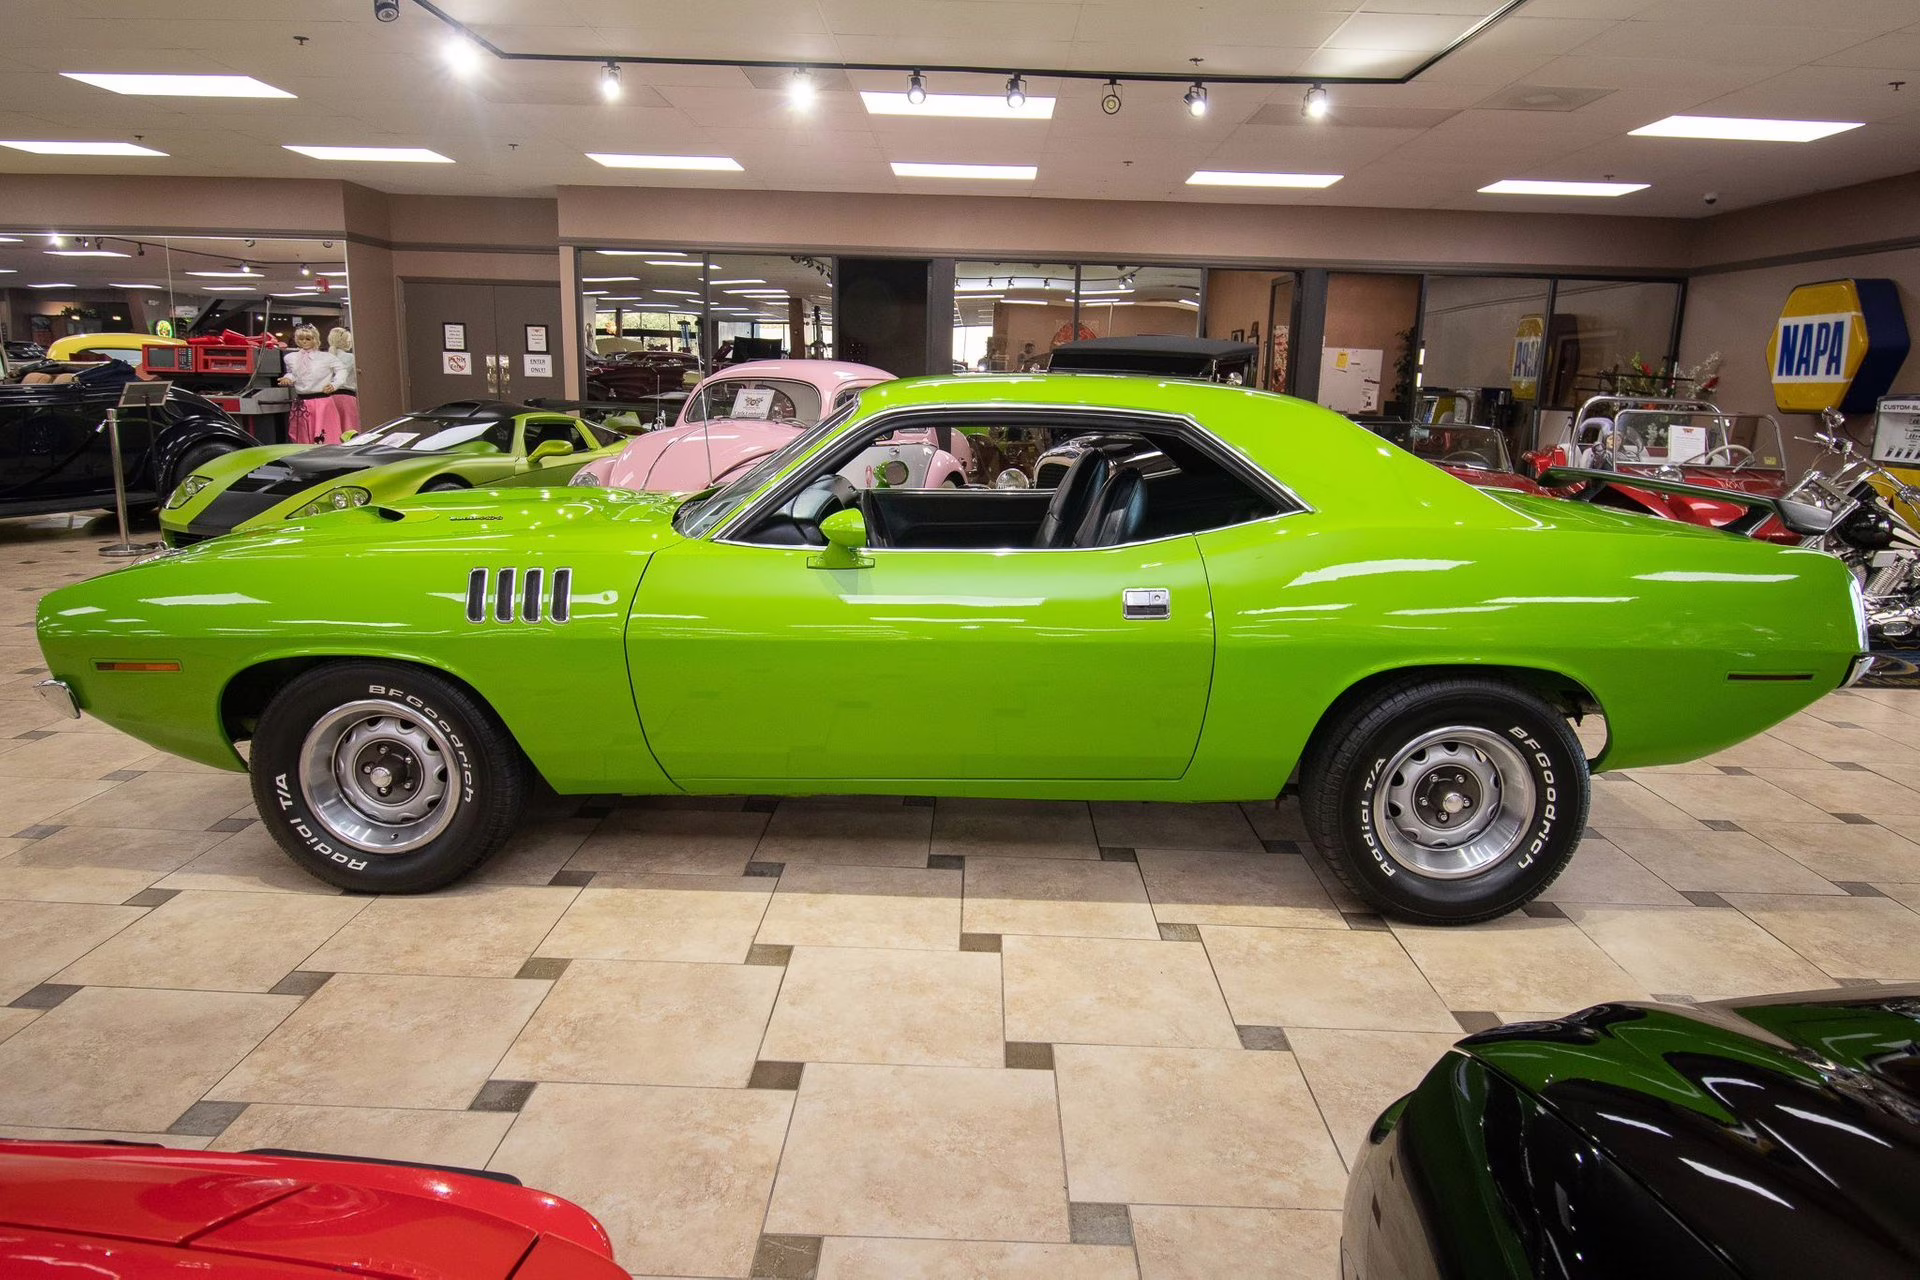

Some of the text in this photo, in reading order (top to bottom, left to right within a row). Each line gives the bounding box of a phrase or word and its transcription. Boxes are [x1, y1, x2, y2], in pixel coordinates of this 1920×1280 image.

[1777, 320, 1845, 377] NAPA
[369, 685, 475, 803] BFGoodrich
[1508, 726, 1557, 870] BFGoodrich
[273, 773, 368, 872] Radial T/A
[1360, 757, 1397, 878] Radial T/A
